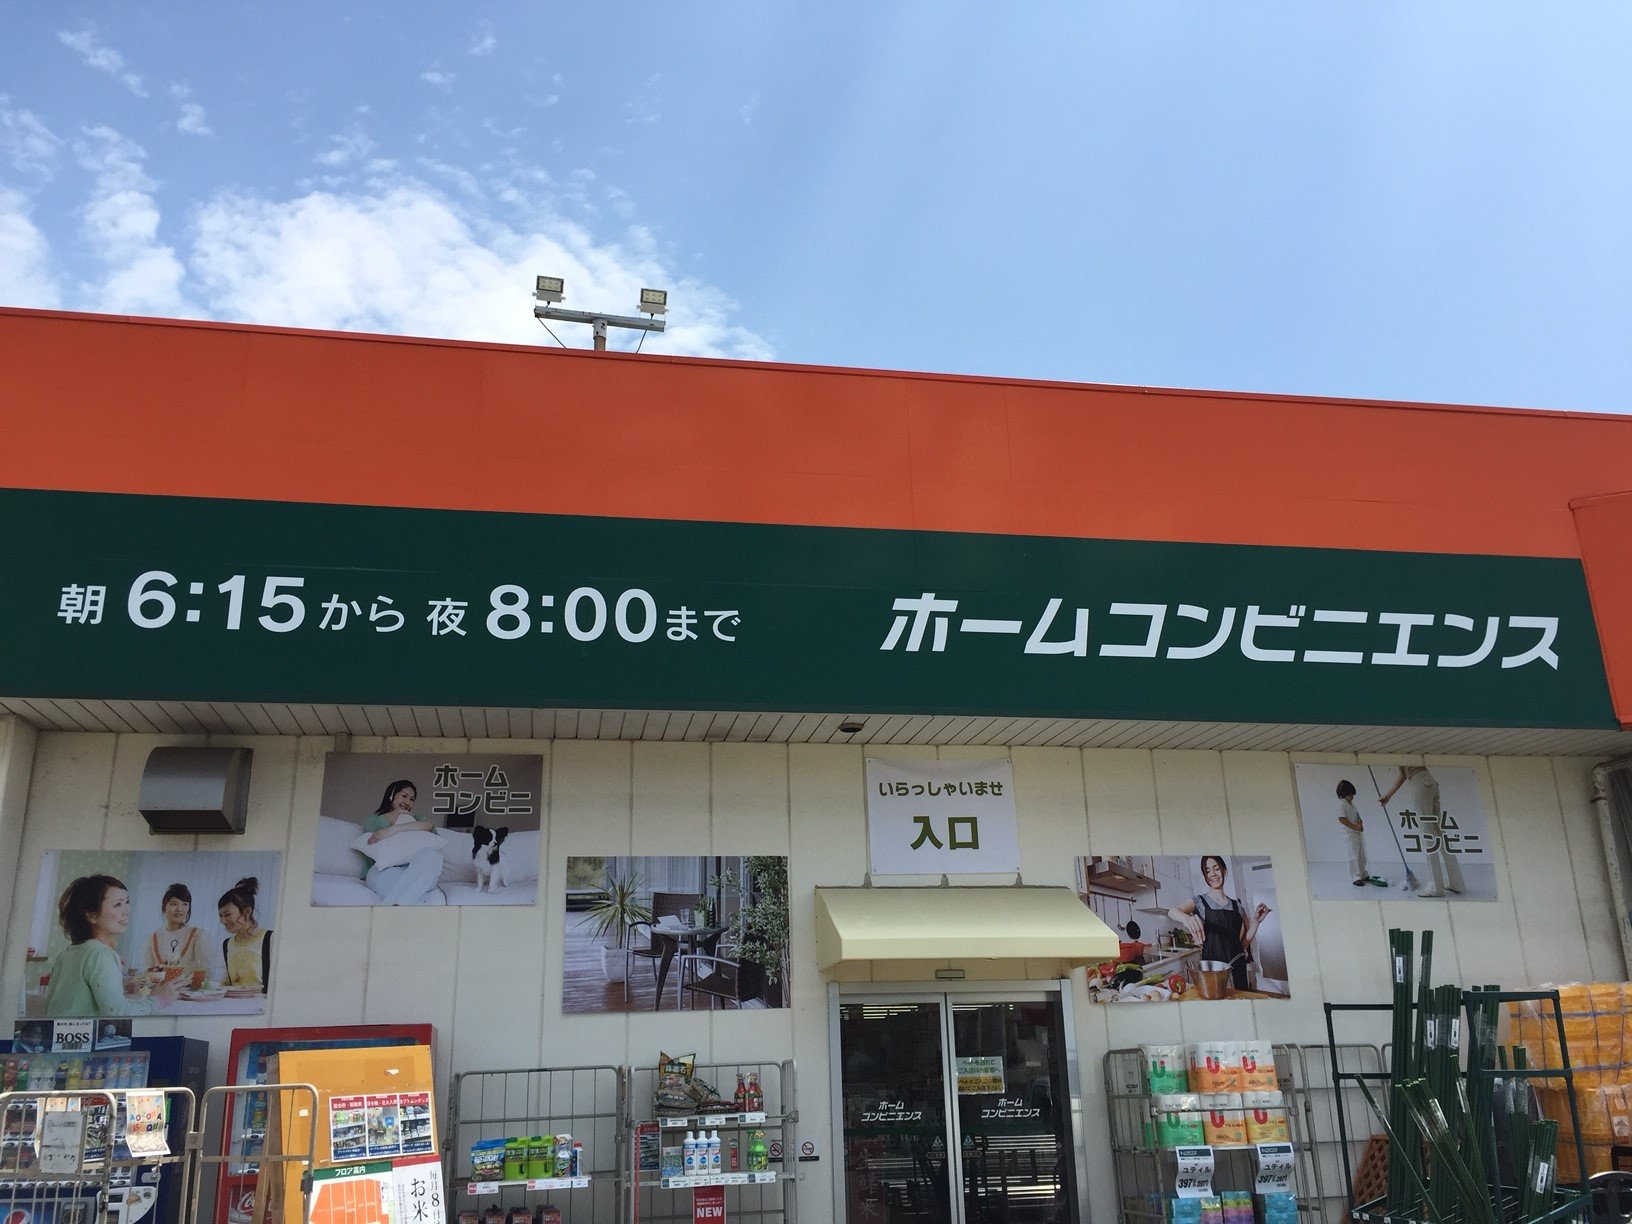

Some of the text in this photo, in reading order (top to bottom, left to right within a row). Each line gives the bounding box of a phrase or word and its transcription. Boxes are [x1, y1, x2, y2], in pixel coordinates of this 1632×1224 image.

[58, 570, 742, 642] 朝 6:15 から 夜 8:00 まで
[880, 592, 1560, 671] ホームコンビニエンス
[433, 764, 510, 788] ホーム
[878, 780, 1003, 797] いらっしゃいませ
[432, 790, 533, 815] コンビニ
[1399, 809, 1460, 831] ホーム
[910, 815, 980, 851] 入口
[1402, 833, 1484, 855] コンビニ
[55, 1032, 90, 1045] BOSS
[878, 1100, 905, 1110] ホーム
[997, 1097, 1023, 1107] ホーム
[861, 1111, 922, 1122] コンビニエンス
[981, 1108, 1041, 1119] コンビニエンス
[334, 1166, 366, 1177] フロア案内
[410, 1178, 428, 1222] お米
[696, 1206, 723, 1218] NEW
